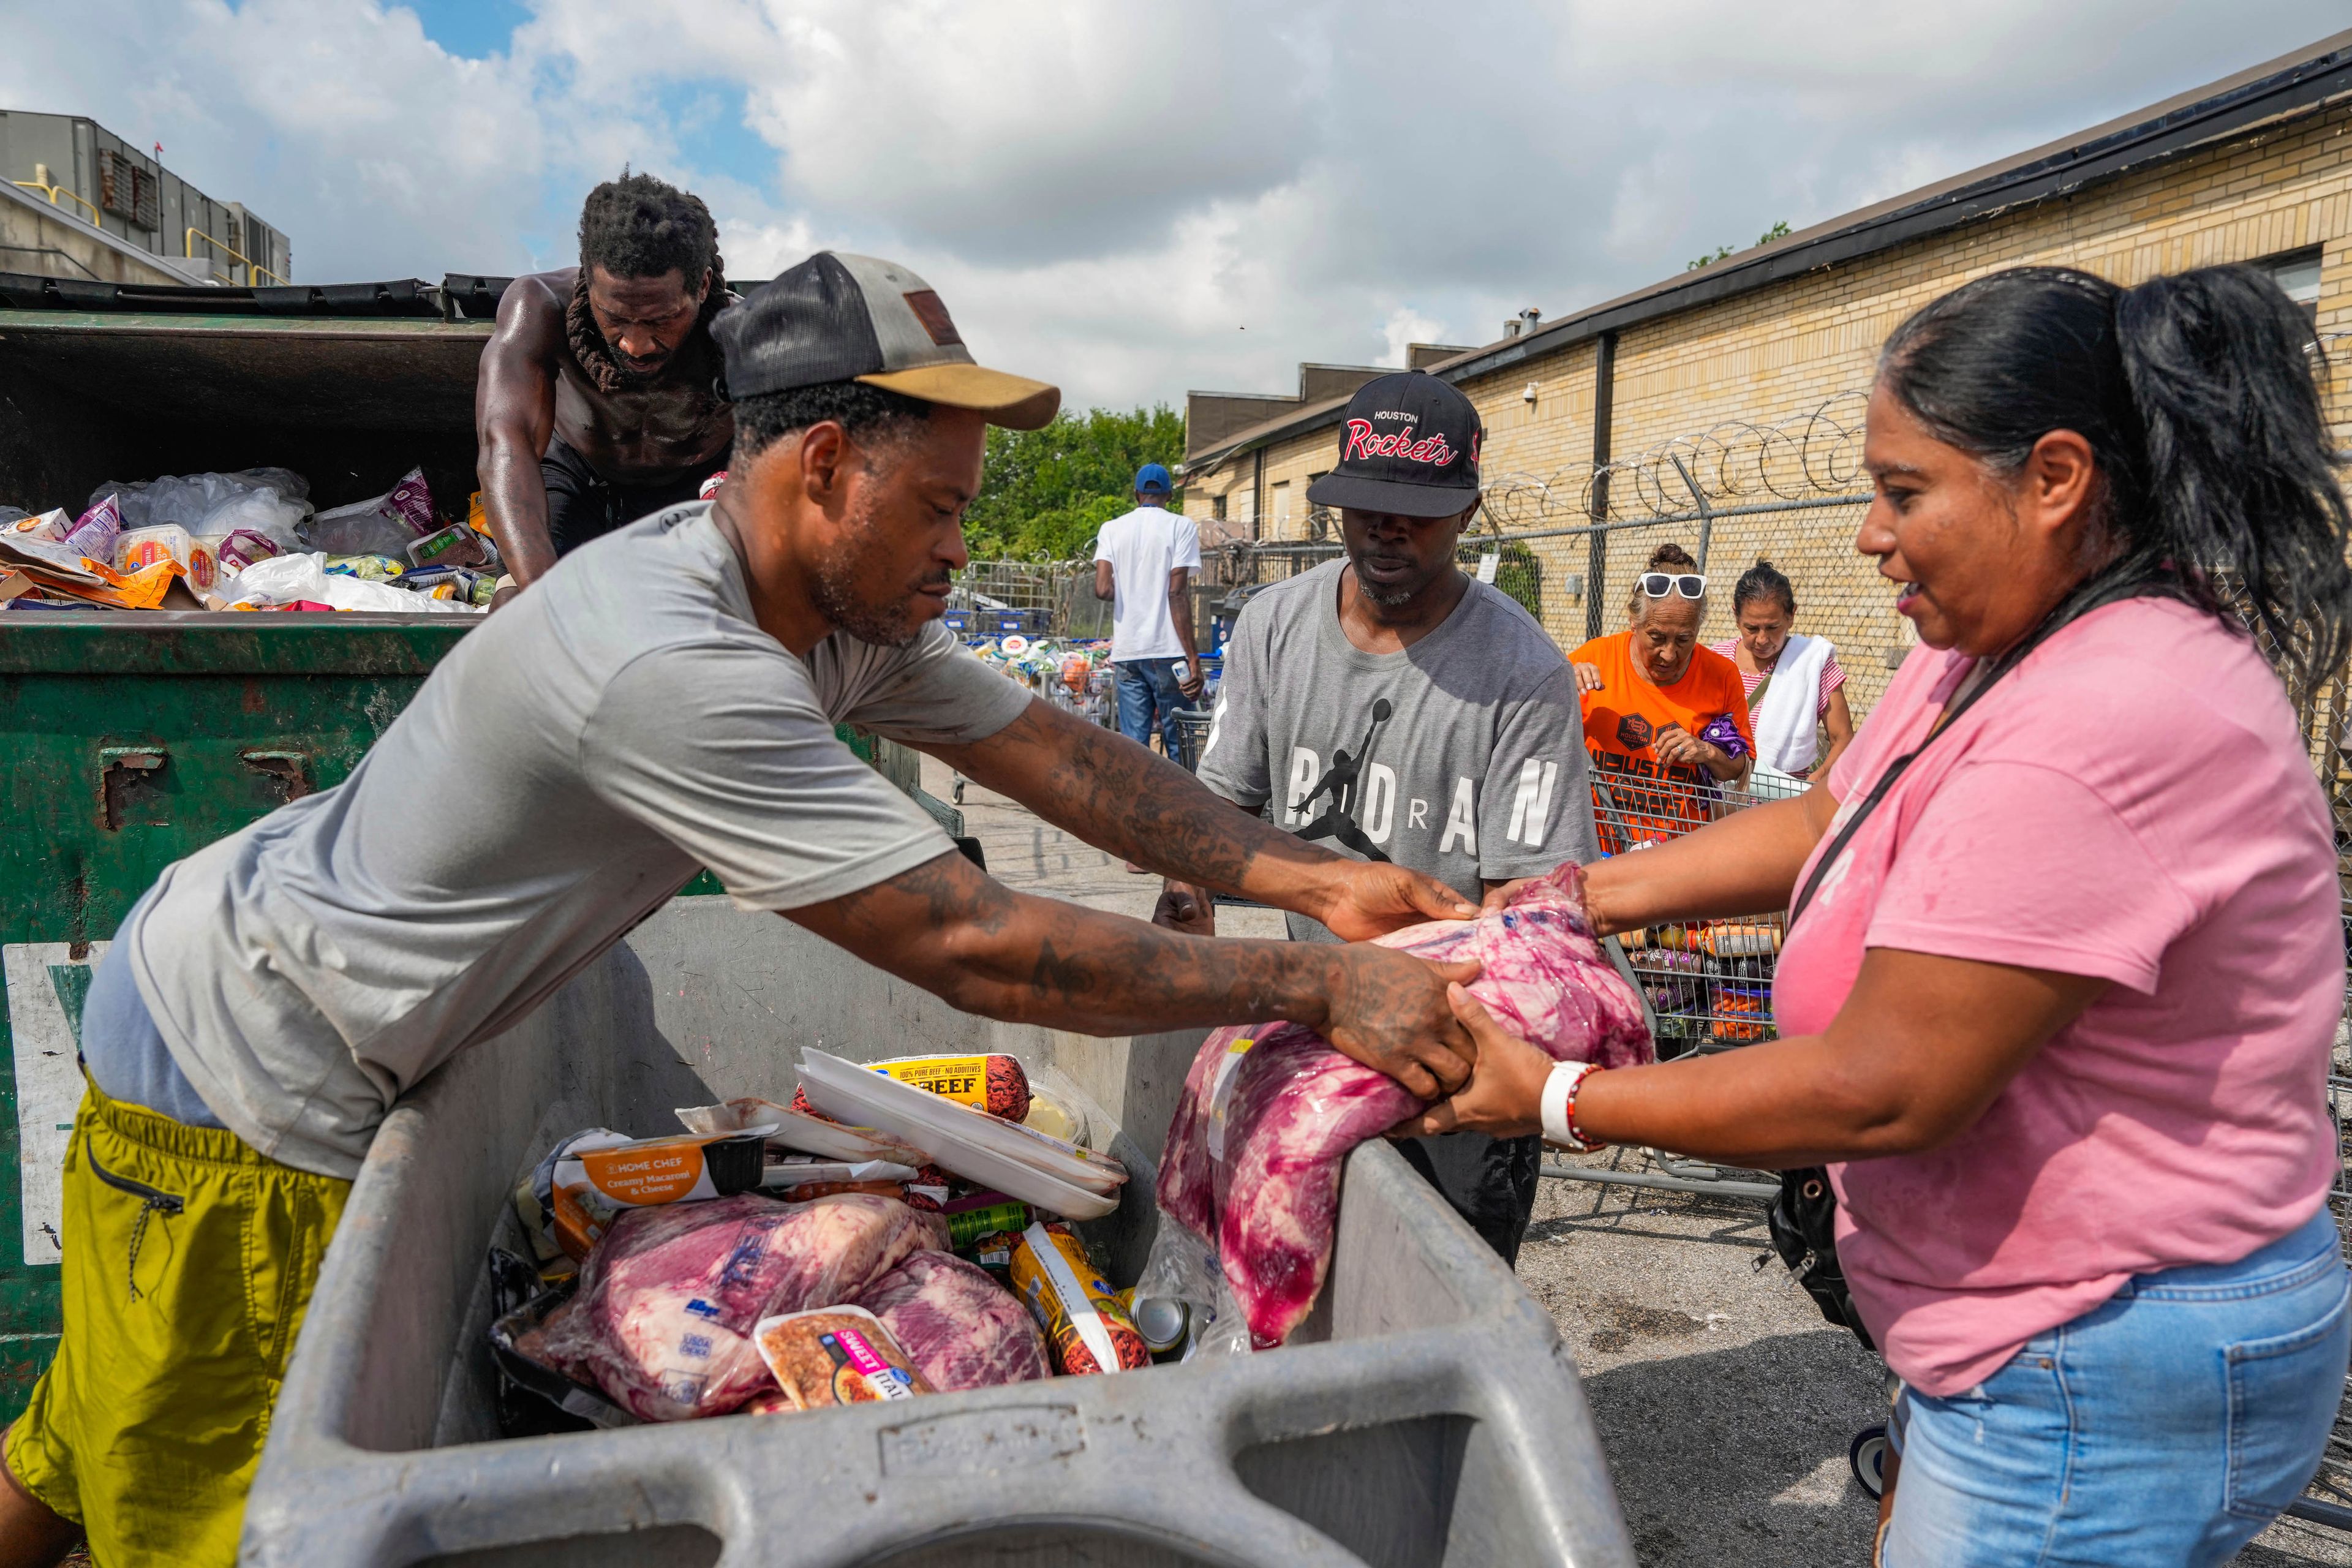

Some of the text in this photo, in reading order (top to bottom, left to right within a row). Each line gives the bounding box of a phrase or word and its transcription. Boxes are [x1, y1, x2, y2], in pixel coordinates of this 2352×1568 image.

[1374, 410, 1419, 424] HOUSTON
[1344, 418, 1458, 467] Rockets
[1620, 731, 1648, 743] HOUSTON
[899, 1069, 913, 1079] 100%
[914, 1068, 928, 1077] PURE
[929, 1067, 941, 1076] BEEF
[954, 1065, 981, 1074] ADDITIVES
[920, 1077, 977, 1095] BEEF
[617, 1156, 683, 1174] HOME CHEF
[607, 1170, 691, 1188] Creamy Macaroni
[630, 1184, 674, 1195] & Cheese
[684, 1334, 710, 1348] USDA
[839, 1330, 881, 1369] SWEET
